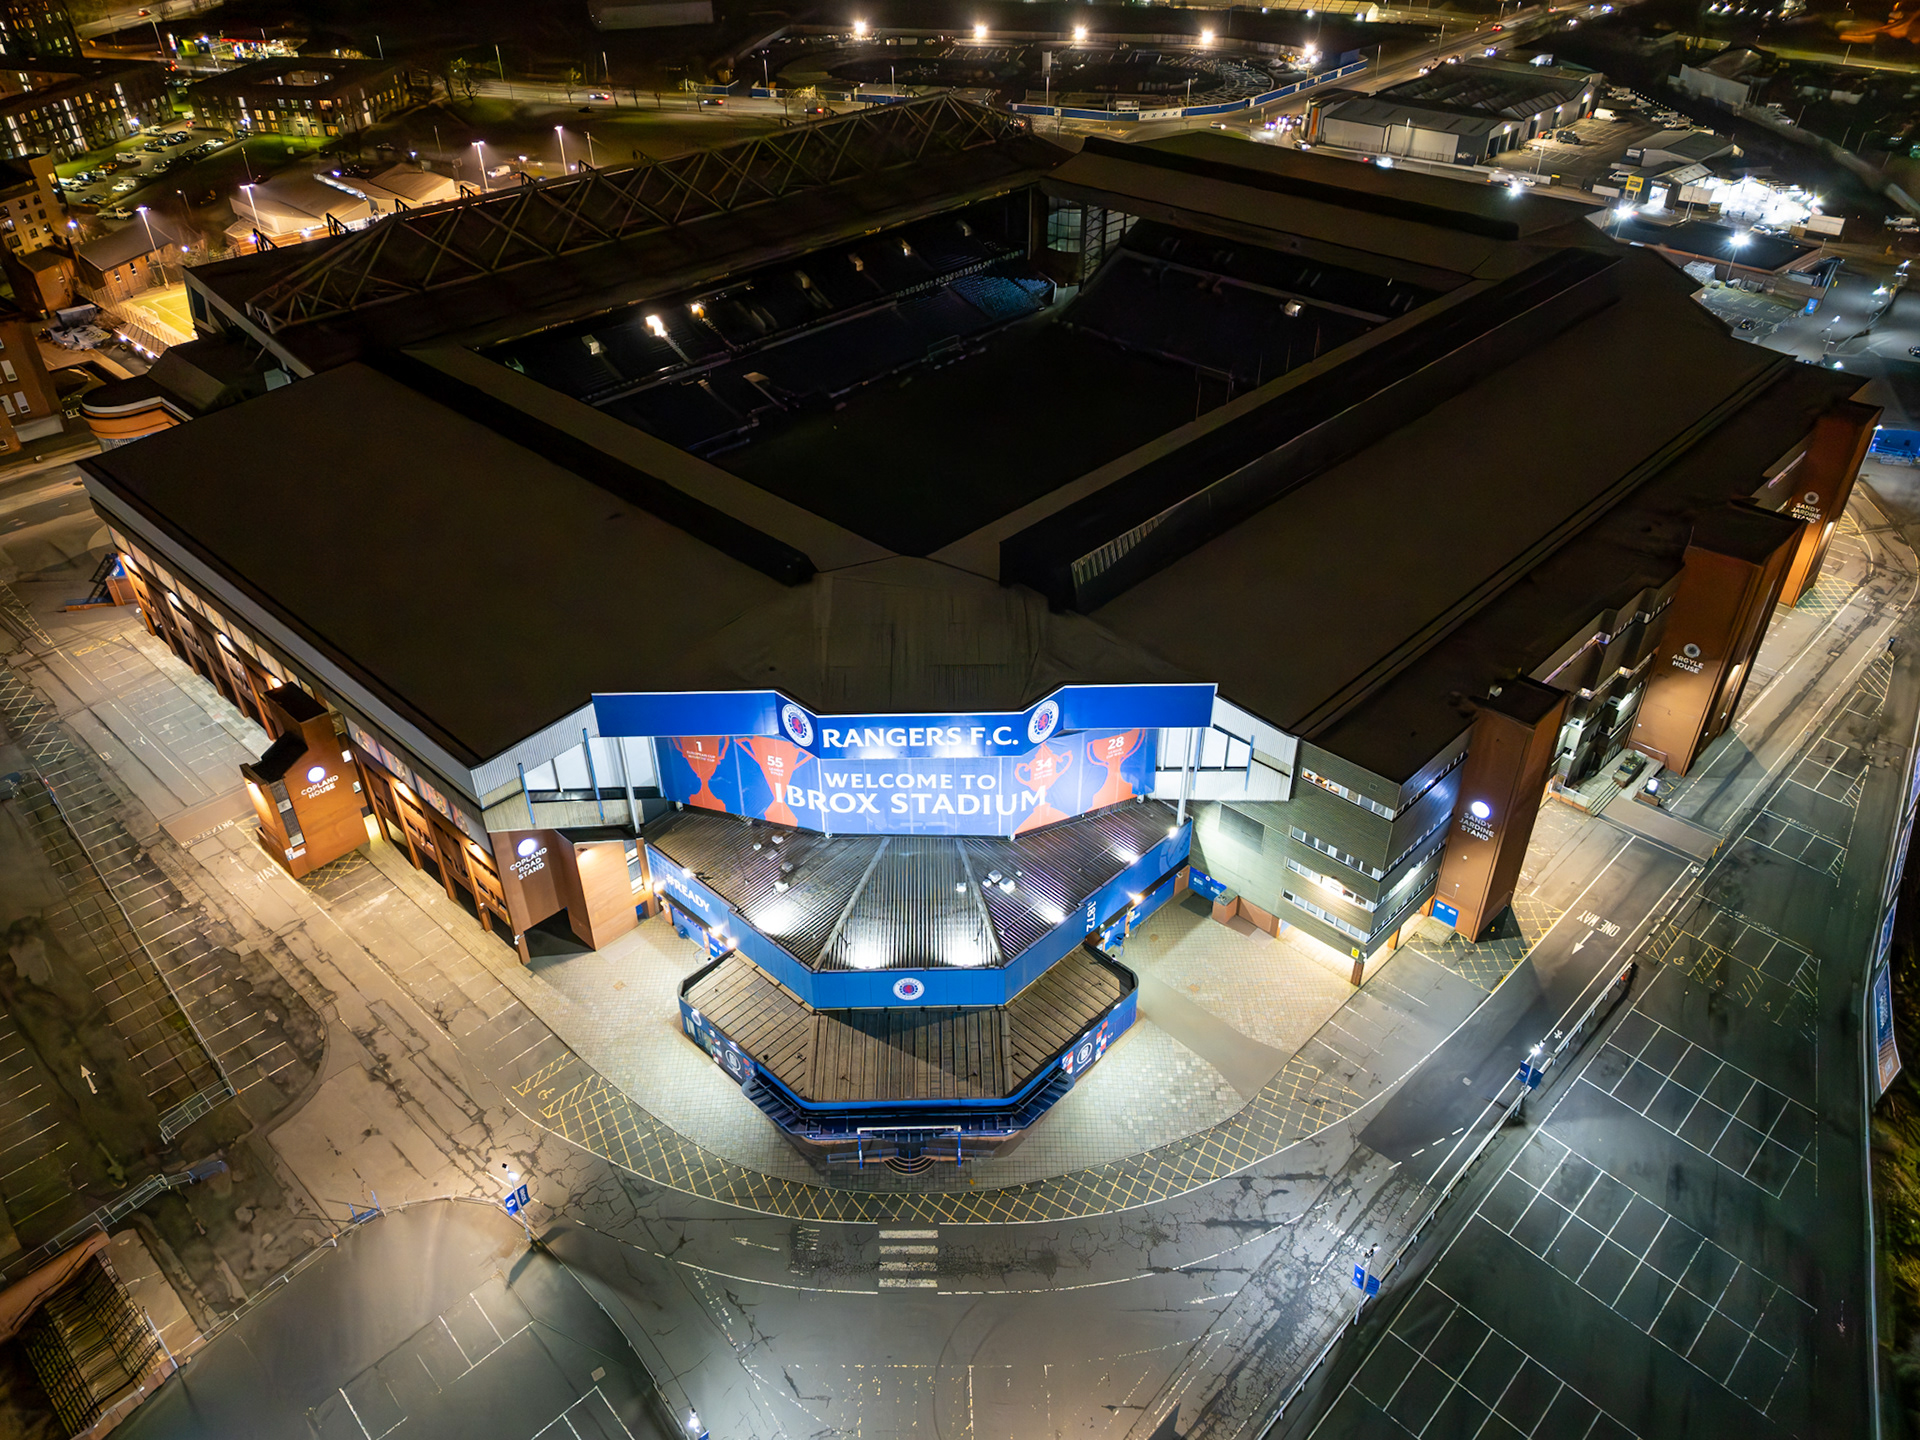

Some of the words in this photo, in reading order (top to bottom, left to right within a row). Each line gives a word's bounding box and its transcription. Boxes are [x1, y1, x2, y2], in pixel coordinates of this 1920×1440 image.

[1672, 654, 1704, 669] ARGYLE
[1672, 660, 1700, 674] HOUSE
[822, 727, 962, 748] RANGERS
[970, 727, 1018, 746] F.C.
[1108, 736, 1124, 750] 28
[696, 741, 702, 752] 1
[767, 755, 783, 767] 55
[1036, 757, 1053, 771] 34
[301, 775, 339, 796] COPLAND
[824, 773, 953, 789] WELCOME
[961, 774, 996, 790] TO
[308, 782, 336, 799] HOUSE
[774, 782, 880, 814] IBROX
[891, 785, 1046, 816] STADIUM
[1459, 818, 1495, 838] JARDINE
[1463, 812, 1492, 829] SANDY
[1461, 825, 1489, 841] STAND
[510, 847, 547, 871] COPLAND
[518, 857, 542, 873] ROAD
[518, 862, 545, 880] STAND
[666, 873, 710, 912] #READY
[1576, 909, 1601, 928] WAY
[1596, 918, 1621, 938] ONE
